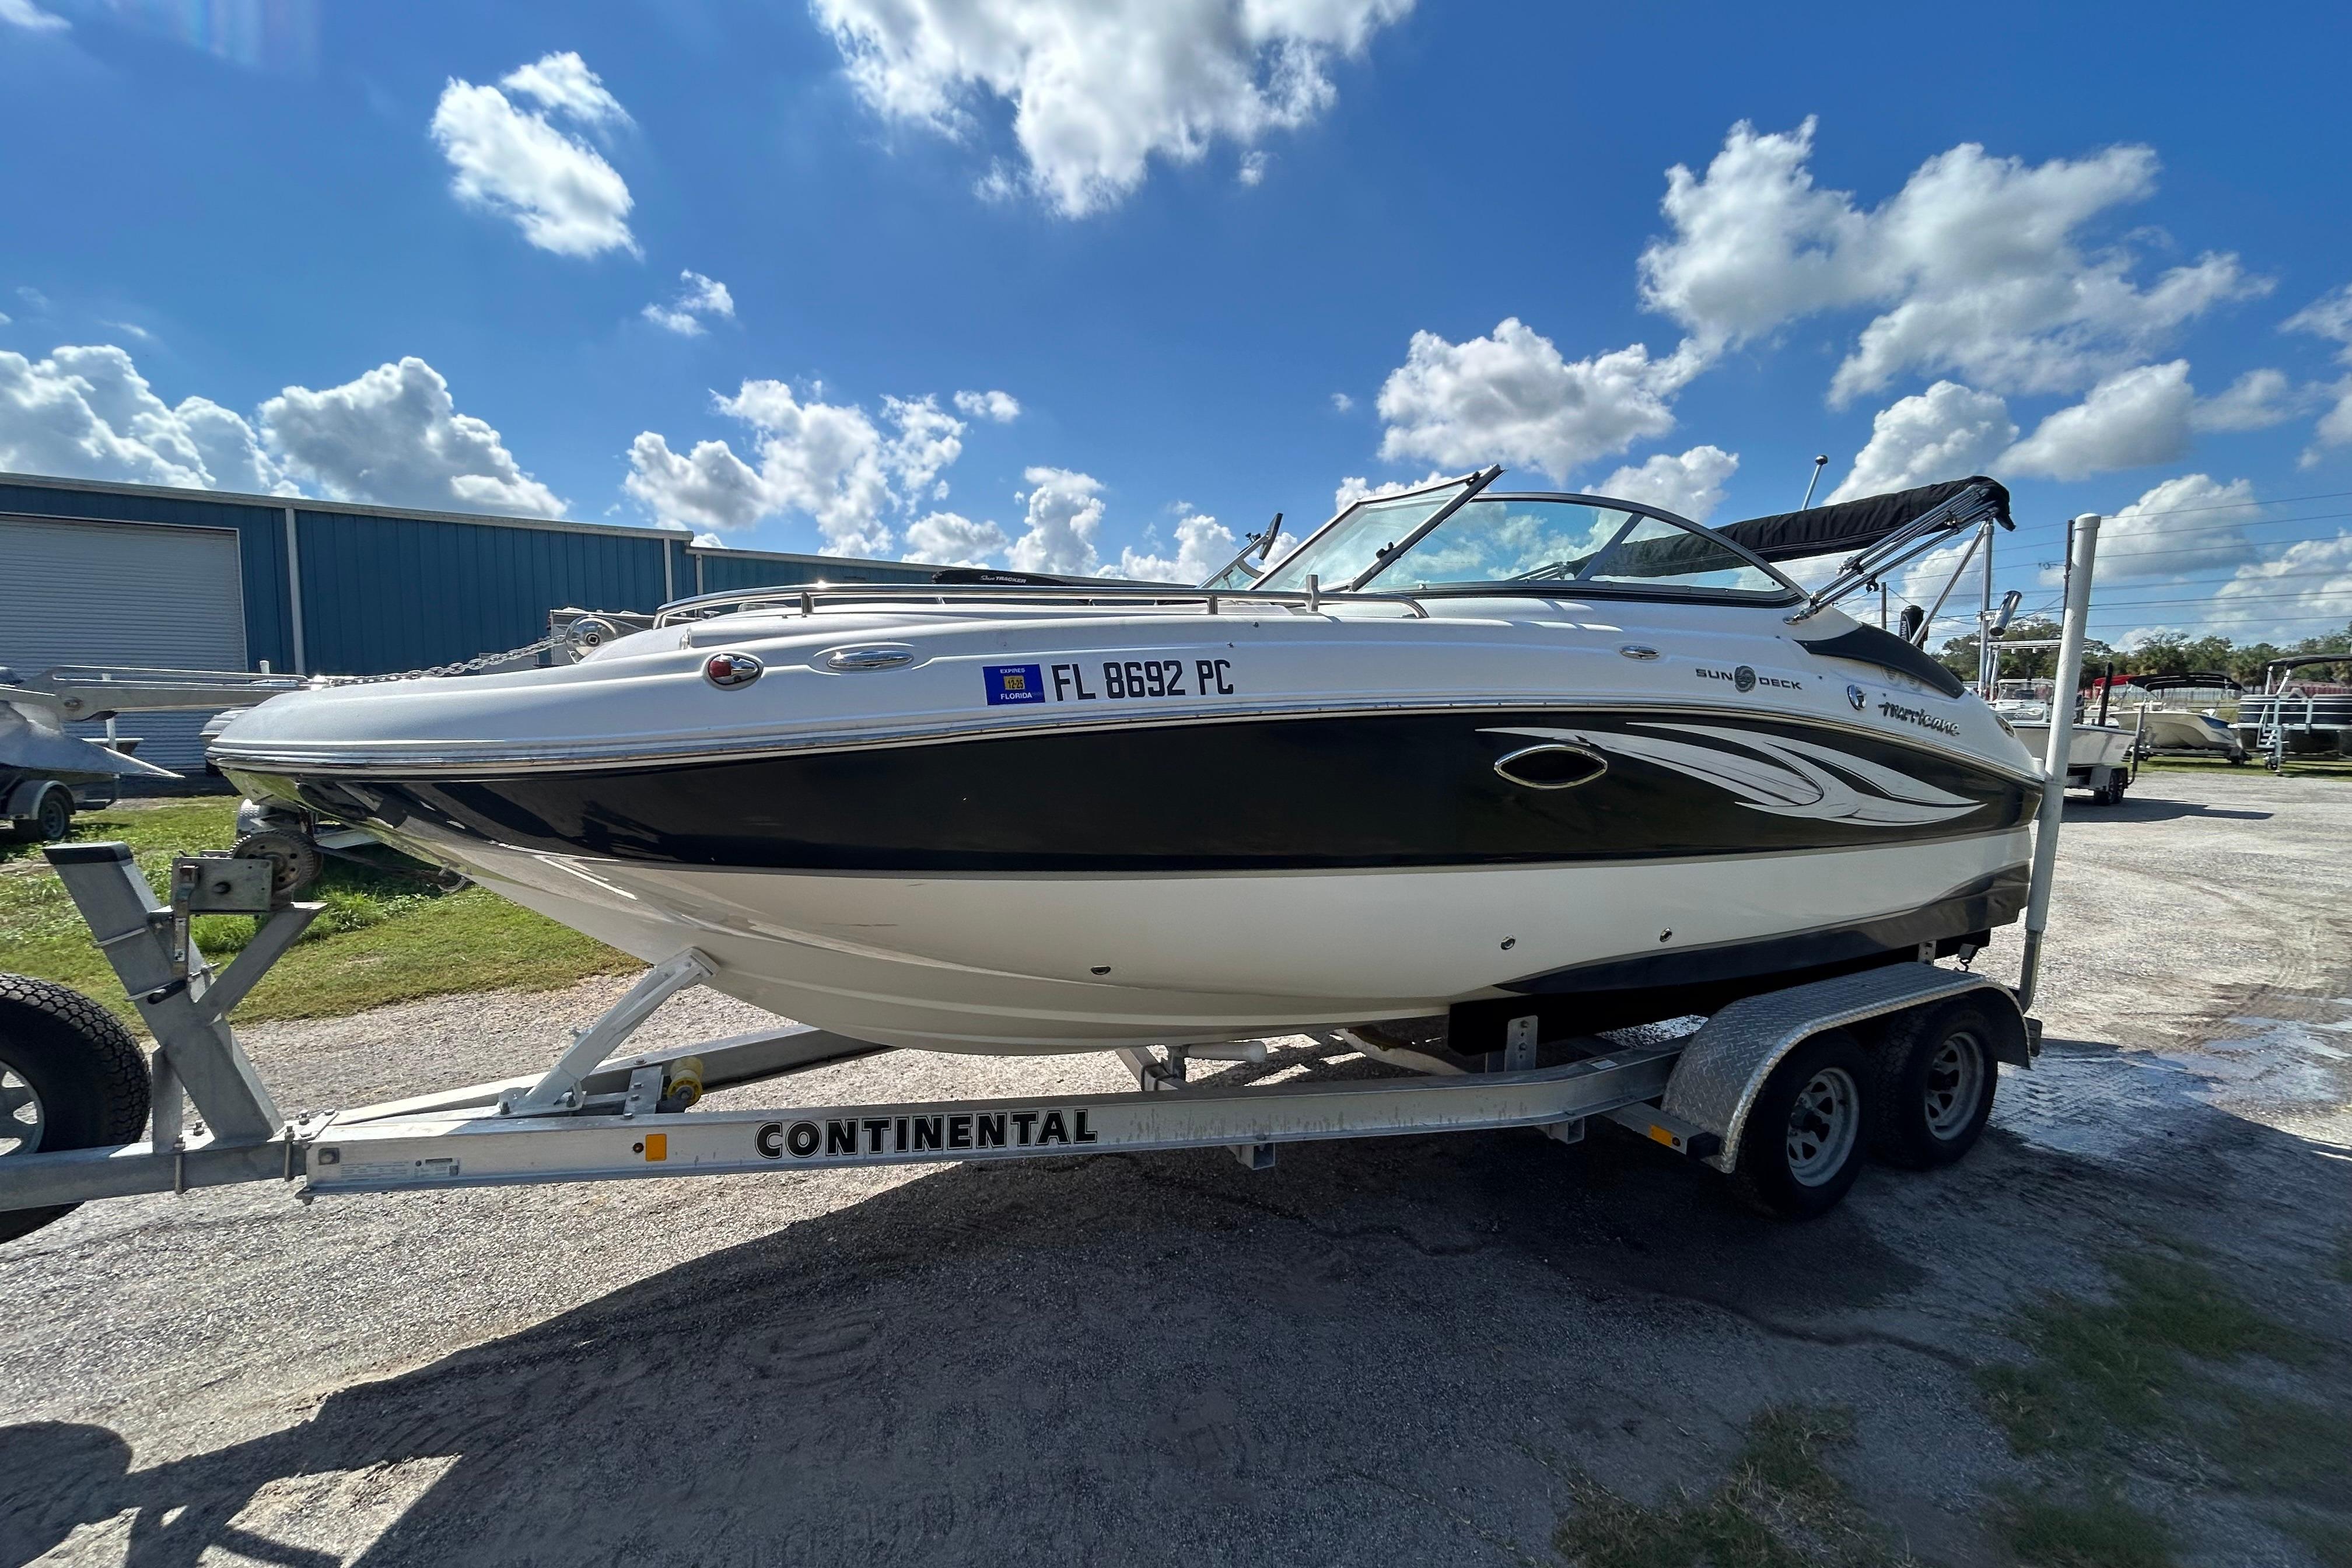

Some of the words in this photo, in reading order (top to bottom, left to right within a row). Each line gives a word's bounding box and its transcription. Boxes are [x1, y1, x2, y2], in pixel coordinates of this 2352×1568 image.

[1051, 664, 1096, 701] FL
[1102, 660, 1185, 699] 8692
[1196, 660, 1234, 695] PC
[1696, 668, 1733, 681] SUN
[1758, 676, 1803, 690] DECK
[754, 1110, 1097, 1158] CONTINENTAL
